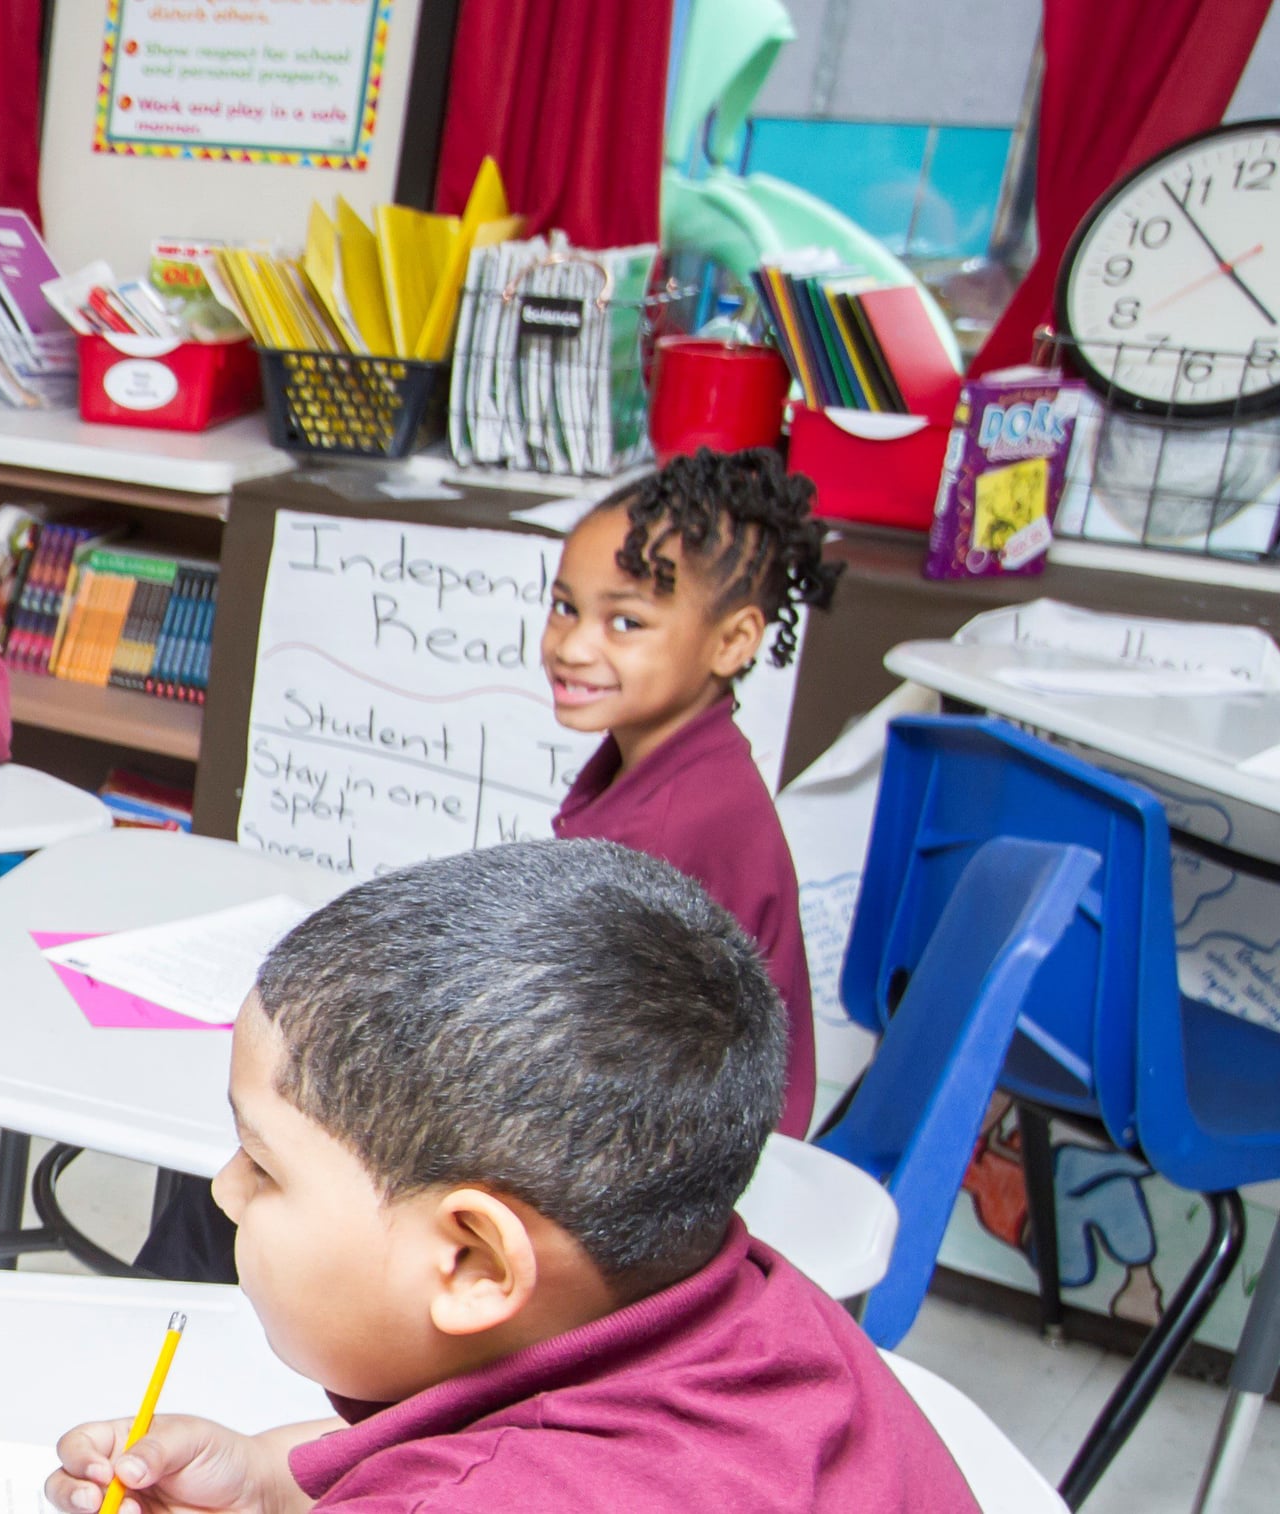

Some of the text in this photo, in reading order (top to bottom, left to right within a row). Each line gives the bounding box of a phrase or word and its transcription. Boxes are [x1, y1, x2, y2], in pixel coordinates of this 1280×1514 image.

[142, 61, 174, 77] and
[145, 43, 188, 57] Show
[261, 45, 289, 60] for
[295, 47, 351, 64] school
[138, 97, 183, 114] Work
[189, 100, 222, 117] and
[226, 102, 264, 122] play
[271, 103, 289, 119] in
[292, 108, 304, 120] a
[1232, 158, 1277, 191] 12
[1182, 175, 1213, 209] 11
[1128, 215, 1172, 250] 10
[1102, 254, 1134, 287] 9
[1109, 296, 1141, 330] 8
[1145, 332, 1171, 365] 7
[1247, 335, 1280, 369] 5
[1183, 350, 1216, 384] 6
[287, 521, 554, 611] Independ
[372, 590, 528, 669] Read
[283, 688, 454, 763] Student
[252, 737, 468, 824] Stay in one
